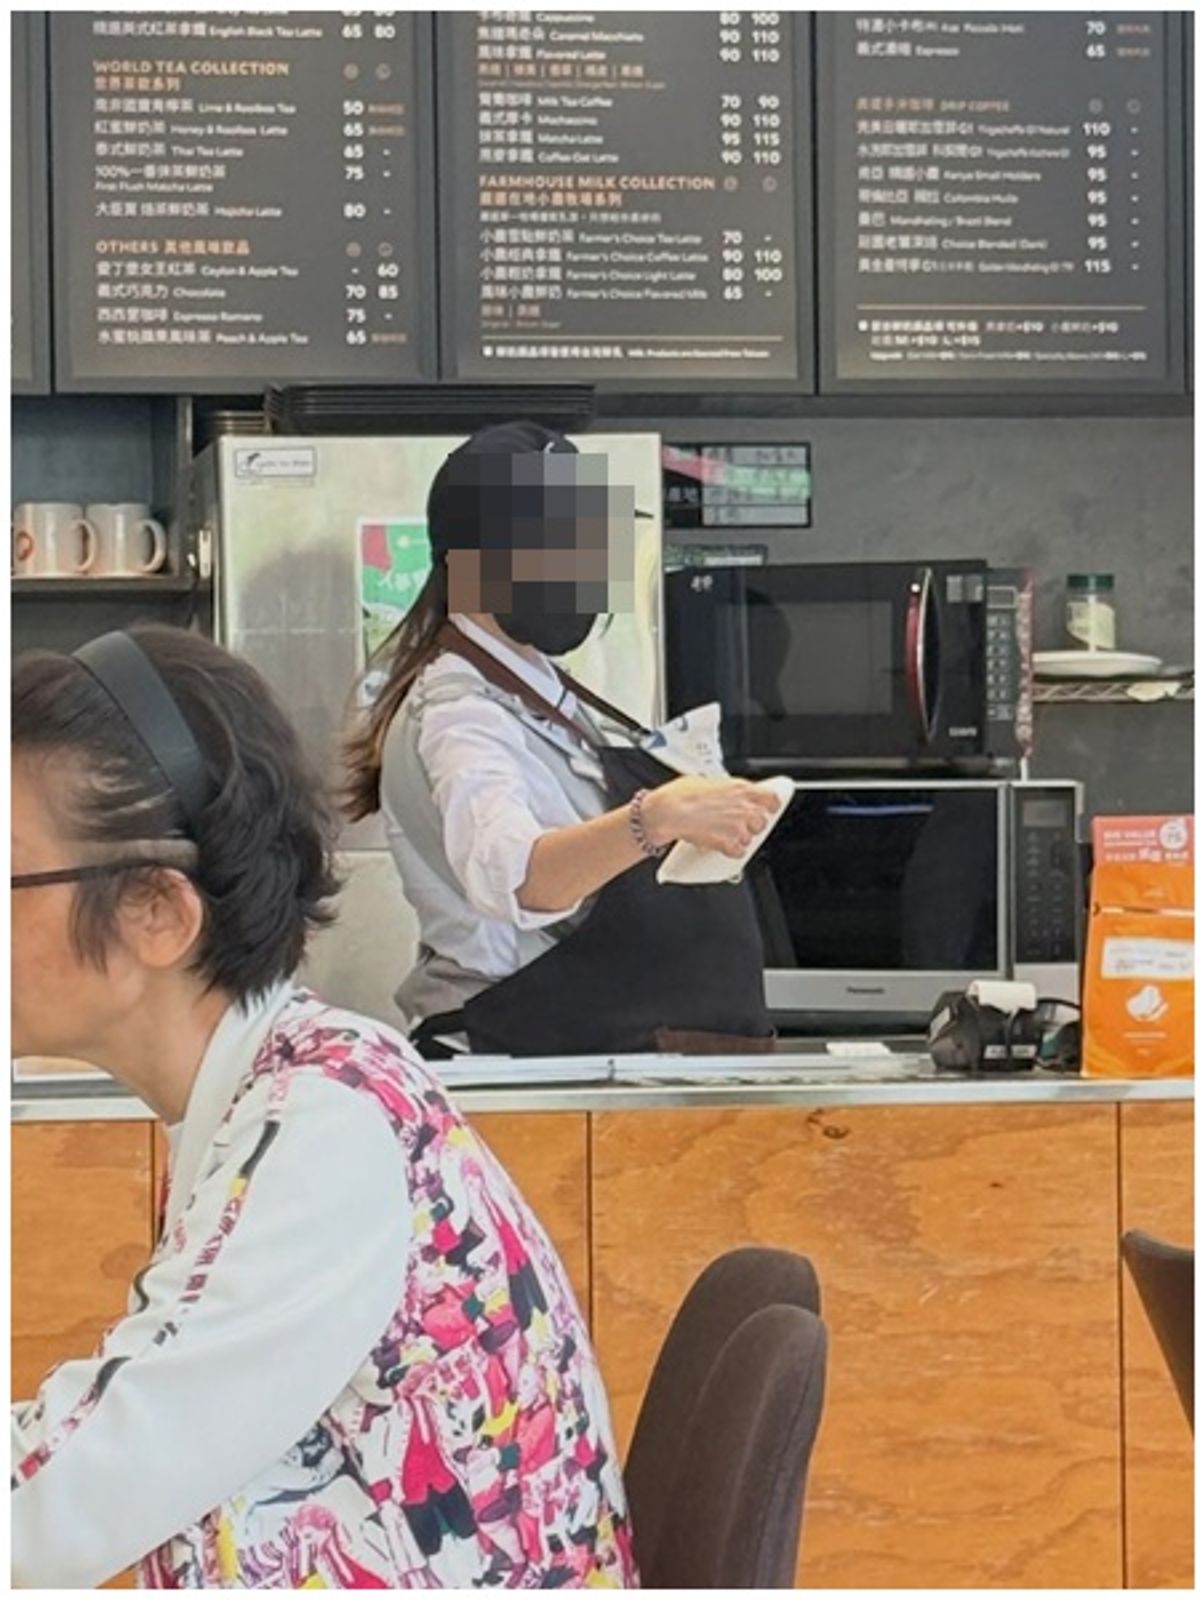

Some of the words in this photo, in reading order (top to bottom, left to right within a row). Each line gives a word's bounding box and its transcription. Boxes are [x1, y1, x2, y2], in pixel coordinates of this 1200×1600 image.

[720, 10, 740, 24] 80
[752, 10, 779, 25] 100
[341, 24, 362, 38] 65
[374, 24, 396, 38] 80
[1086, 21, 1106, 35] 70
[720, 29, 741, 43] 90
[752, 30, 779, 43] 110
[720, 48, 741, 62] 90
[753, 49, 780, 62] 110
[1086, 44, 1106, 57] 65
[94, 60, 151, 75] WORLD
[155, 61, 187, 73] TEA
[190, 61, 289, 75] COLLECTION
[343, 101, 363, 115] 50
[721, 95, 741, 108] 70
[758, 95, 779, 109] 90
[721, 114, 742, 127] 90
[753, 114, 780, 127] 110
[343, 123, 363, 136] 65
[1082, 122, 1111, 136] 110
[722, 132, 741, 145] 95
[754, 132, 780, 146] 115
[343, 144, 364, 158] 65
[721, 150, 742, 164] 90
[754, 151, 781, 164] 110
[1087, 145, 1107, 158] 95
[345, 166, 364, 179] 75
[1087, 168, 1107, 181] 95
[480, 176, 574, 189] FARMHOUSE
[578, 176, 616, 189] MILK
[619, 176, 715, 189] COLLECTION
[1087, 191, 1107, 204] 95
[344, 203, 366, 217] 80
[1087, 214, 1107, 227] 95
[722, 231, 742, 244] 70
[1087, 237, 1107, 250] 95
[97, 240, 159, 253] OTHERS
[722, 249, 743, 263] 90
[755, 249, 782, 263] 110
[377, 263, 399, 277] 60
[1085, 259, 1111, 272] 115
[722, 268, 743, 281] 80
[754, 267, 782, 281] 100
[346, 285, 366, 298] 70
[378, 285, 398, 298] 85
[724, 286, 743, 299] 65
[346, 308, 366, 322] 75
[346, 330, 366, 344] 65
